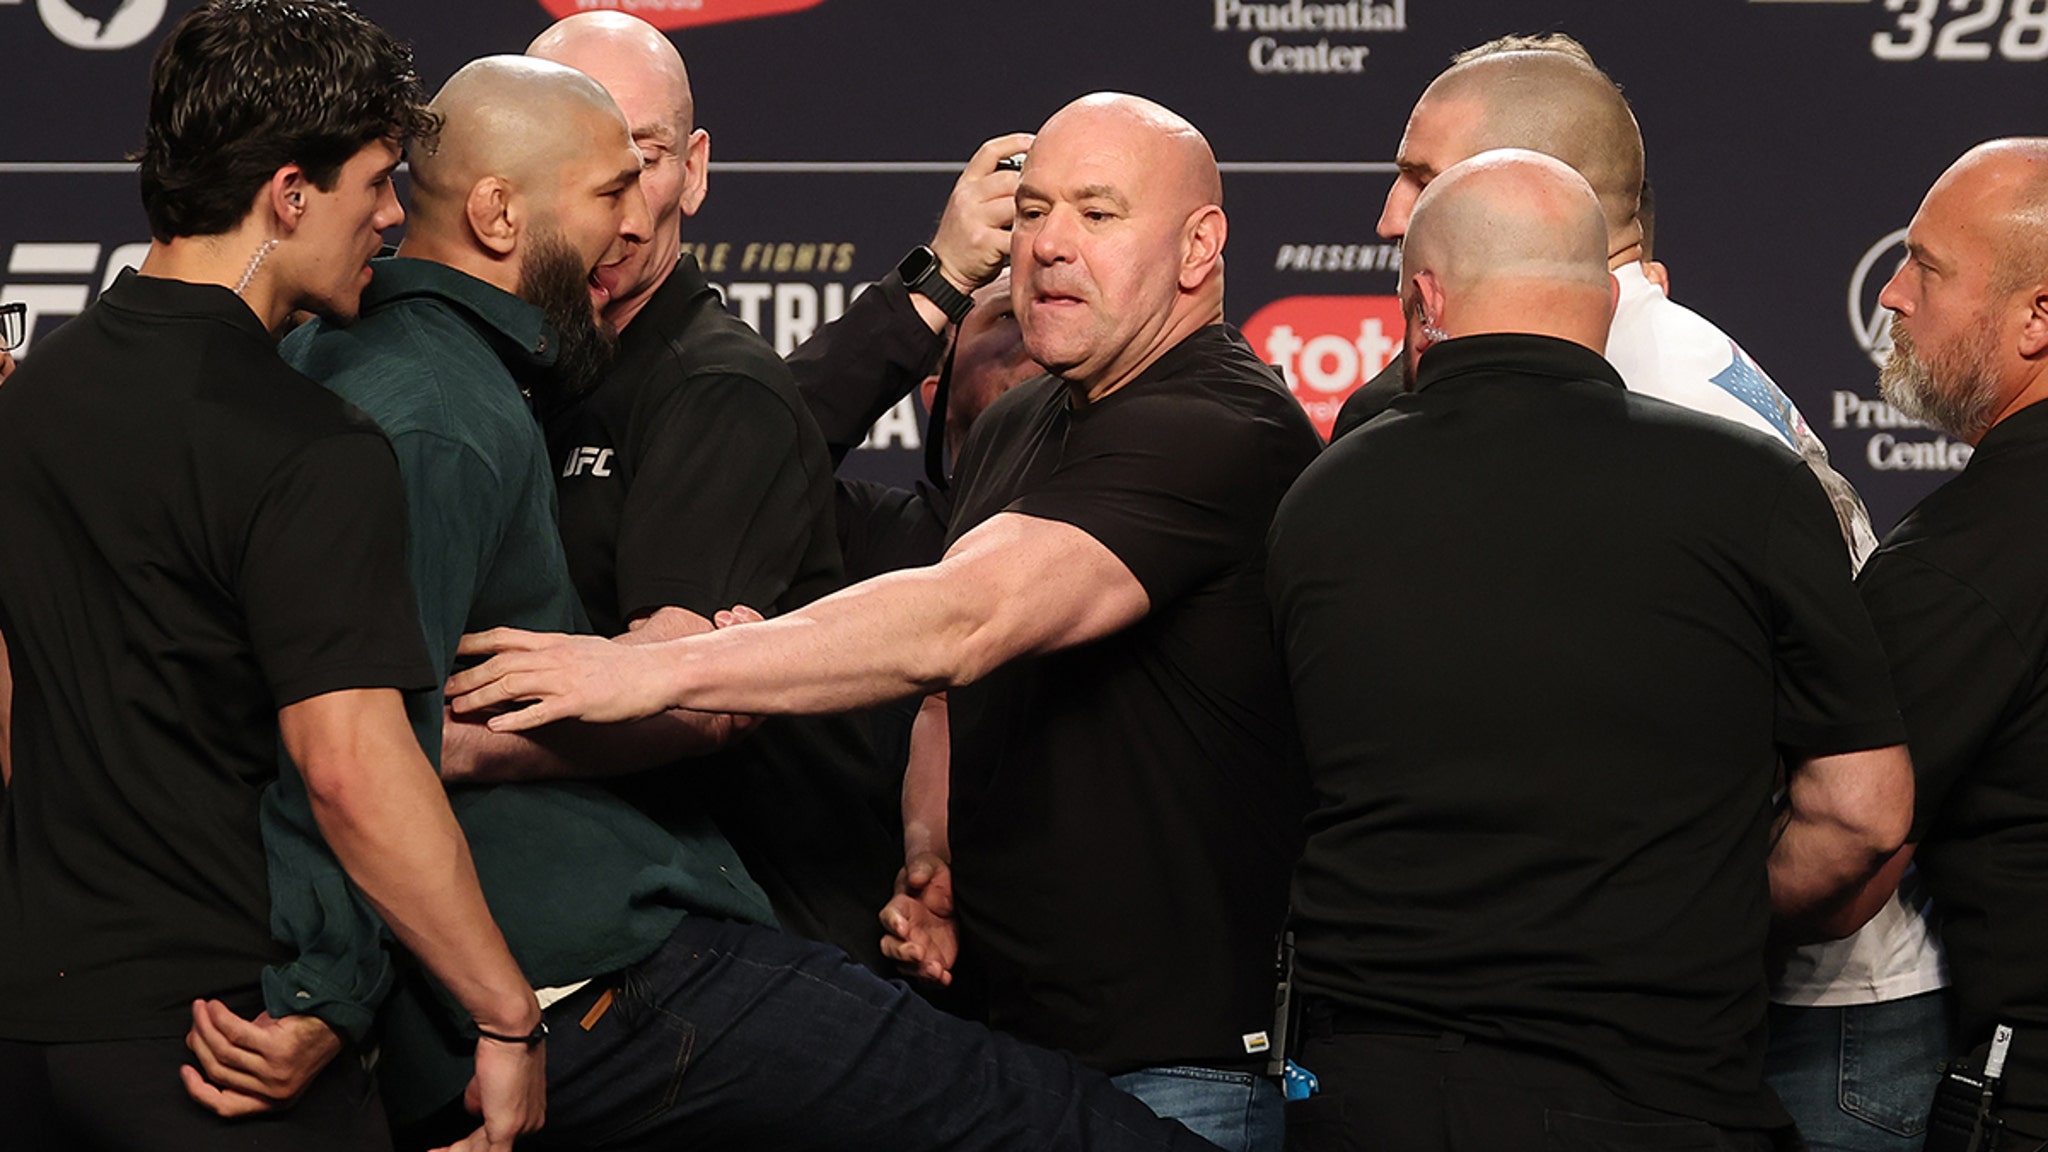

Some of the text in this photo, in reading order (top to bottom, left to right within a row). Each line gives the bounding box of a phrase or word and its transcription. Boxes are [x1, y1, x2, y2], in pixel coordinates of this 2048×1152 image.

[1213, 0, 1406, 31] Prudential
[1871, 0, 2048, 61] 328
[1248, 36, 1370, 74] Center
[740, 242, 856, 272] FIGHTS
[708, 282, 876, 360] TRI
[1265, 317, 1404, 393] tot
[562, 446, 615, 478] UFC
